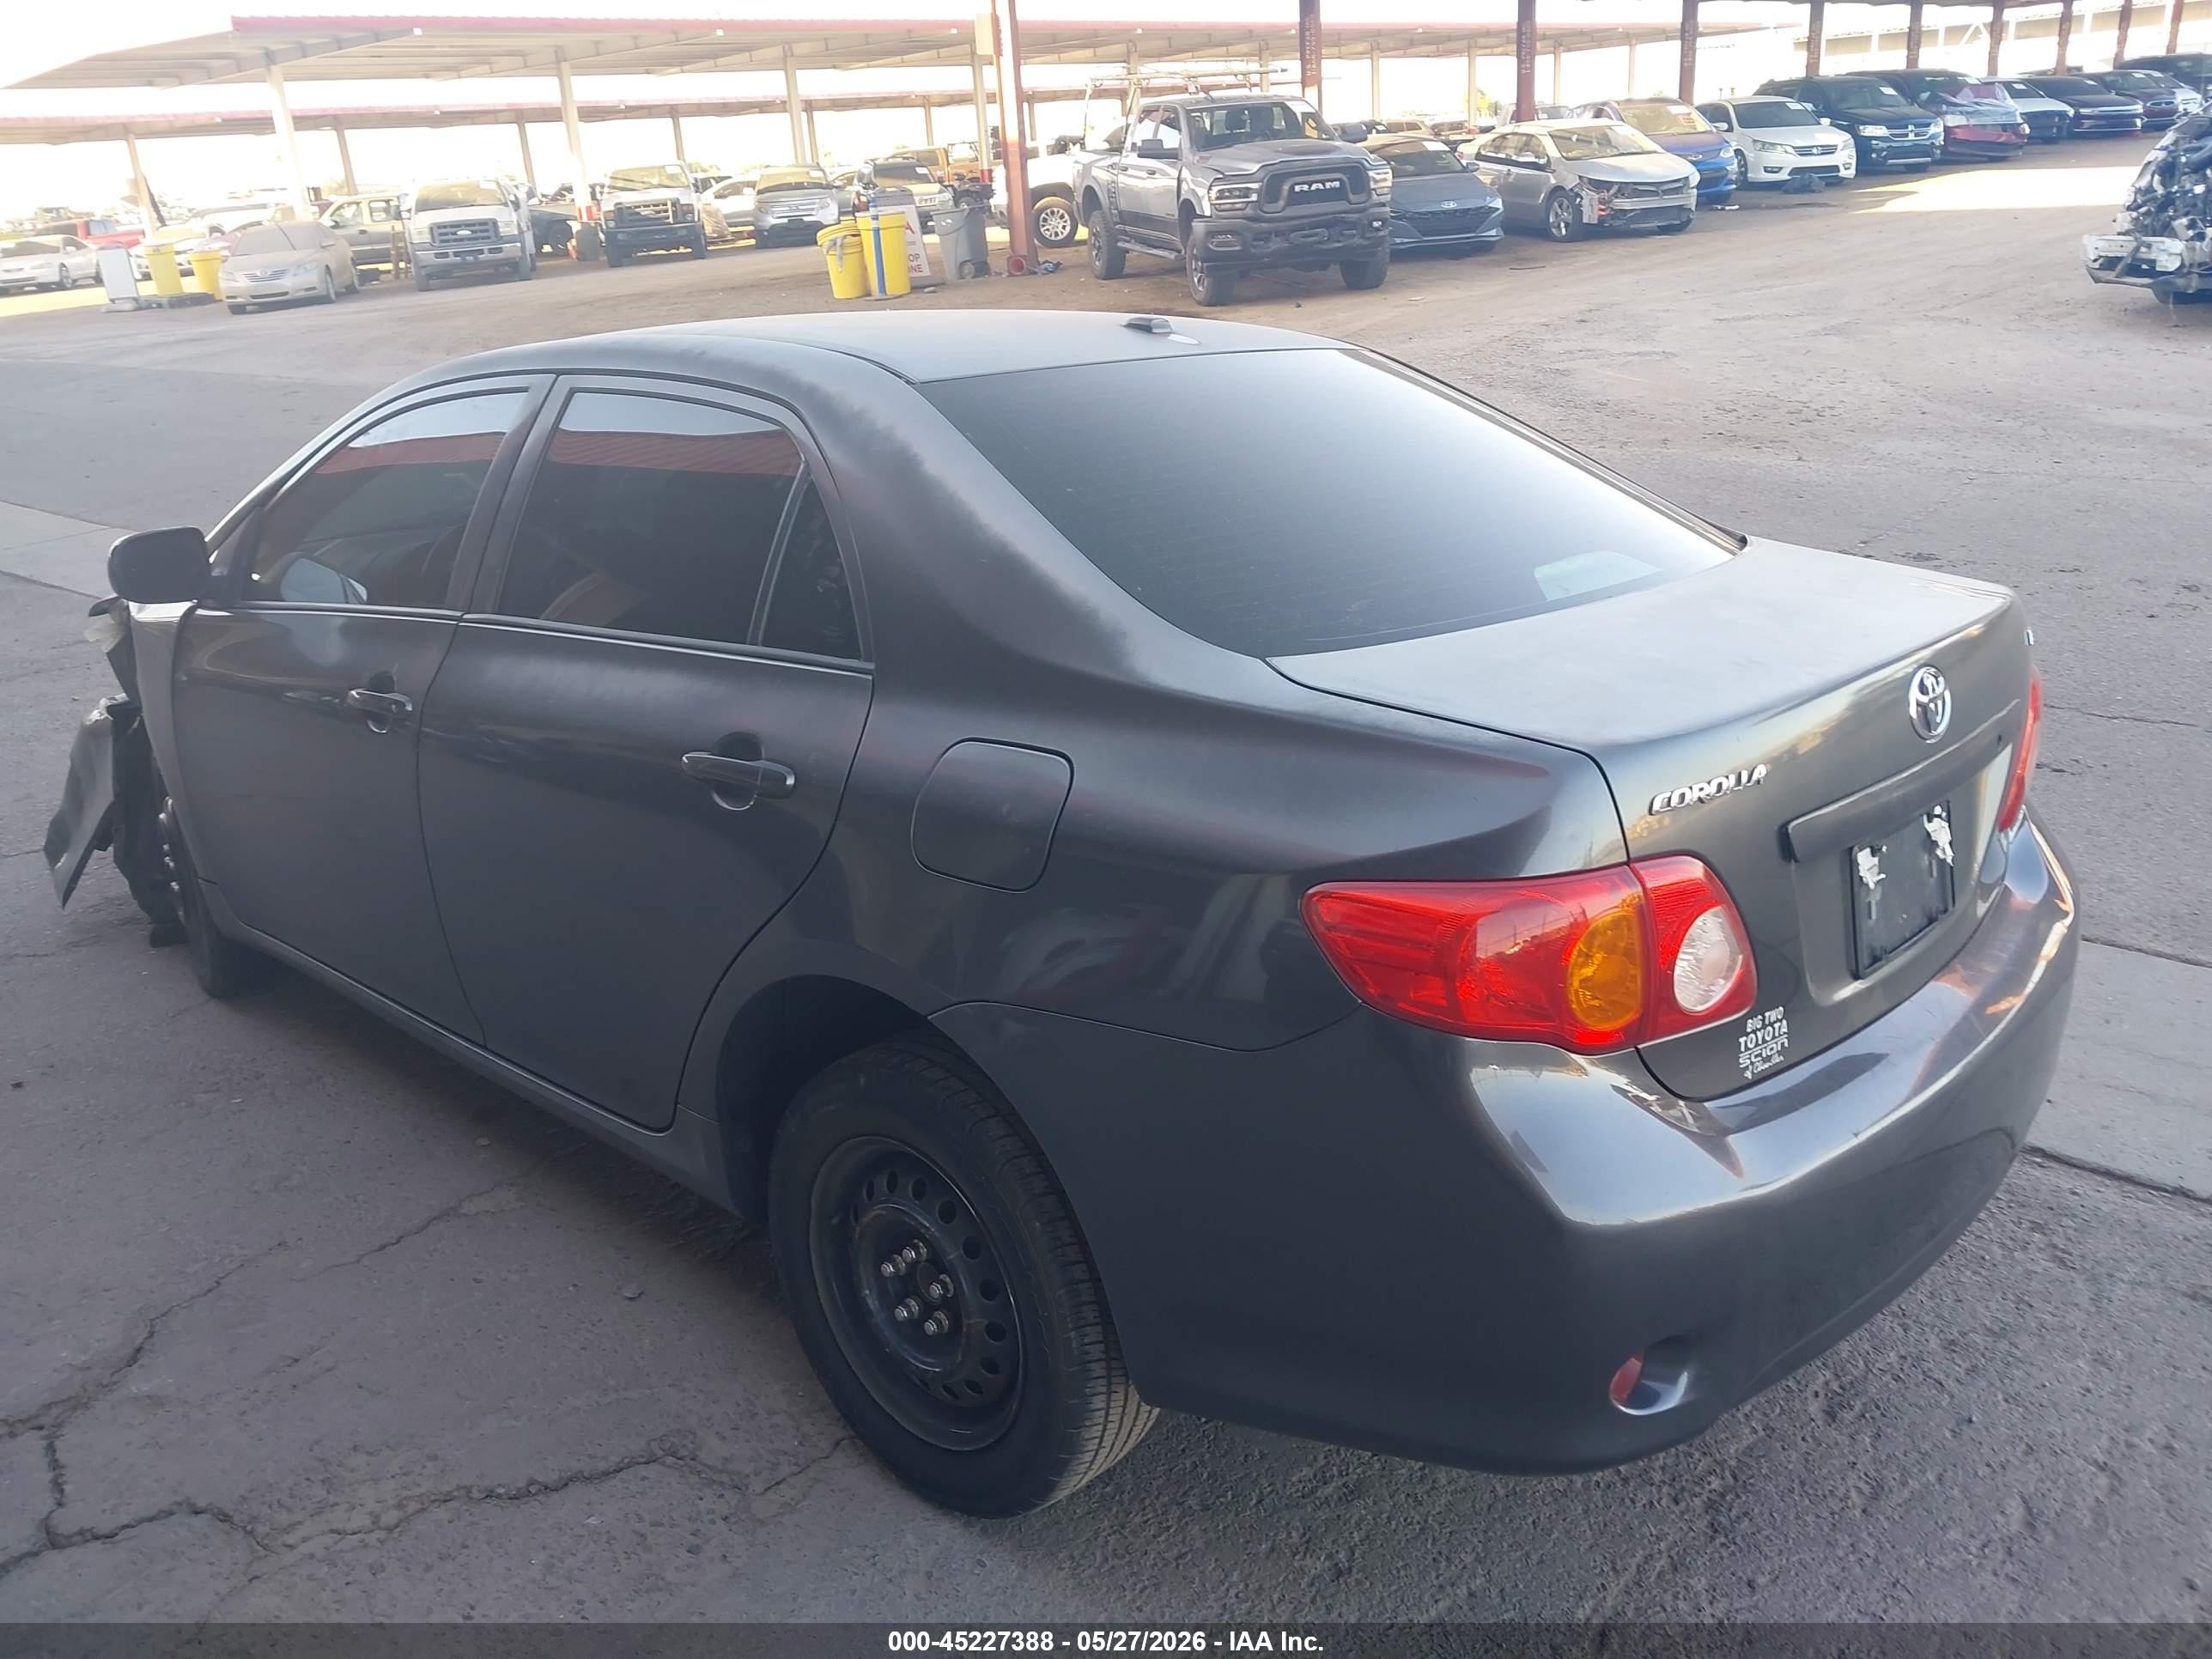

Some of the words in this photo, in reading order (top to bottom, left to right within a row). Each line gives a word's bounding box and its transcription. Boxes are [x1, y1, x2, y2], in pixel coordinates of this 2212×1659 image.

[1294, 180, 1340, 192] RAM
[1649, 763, 1767, 815] COROLLA
[1746, 1014, 1764, 1033] BIG
[1764, 1006, 1784, 1024] TWO
[1738, 1018, 1788, 1052] TOYOTA
